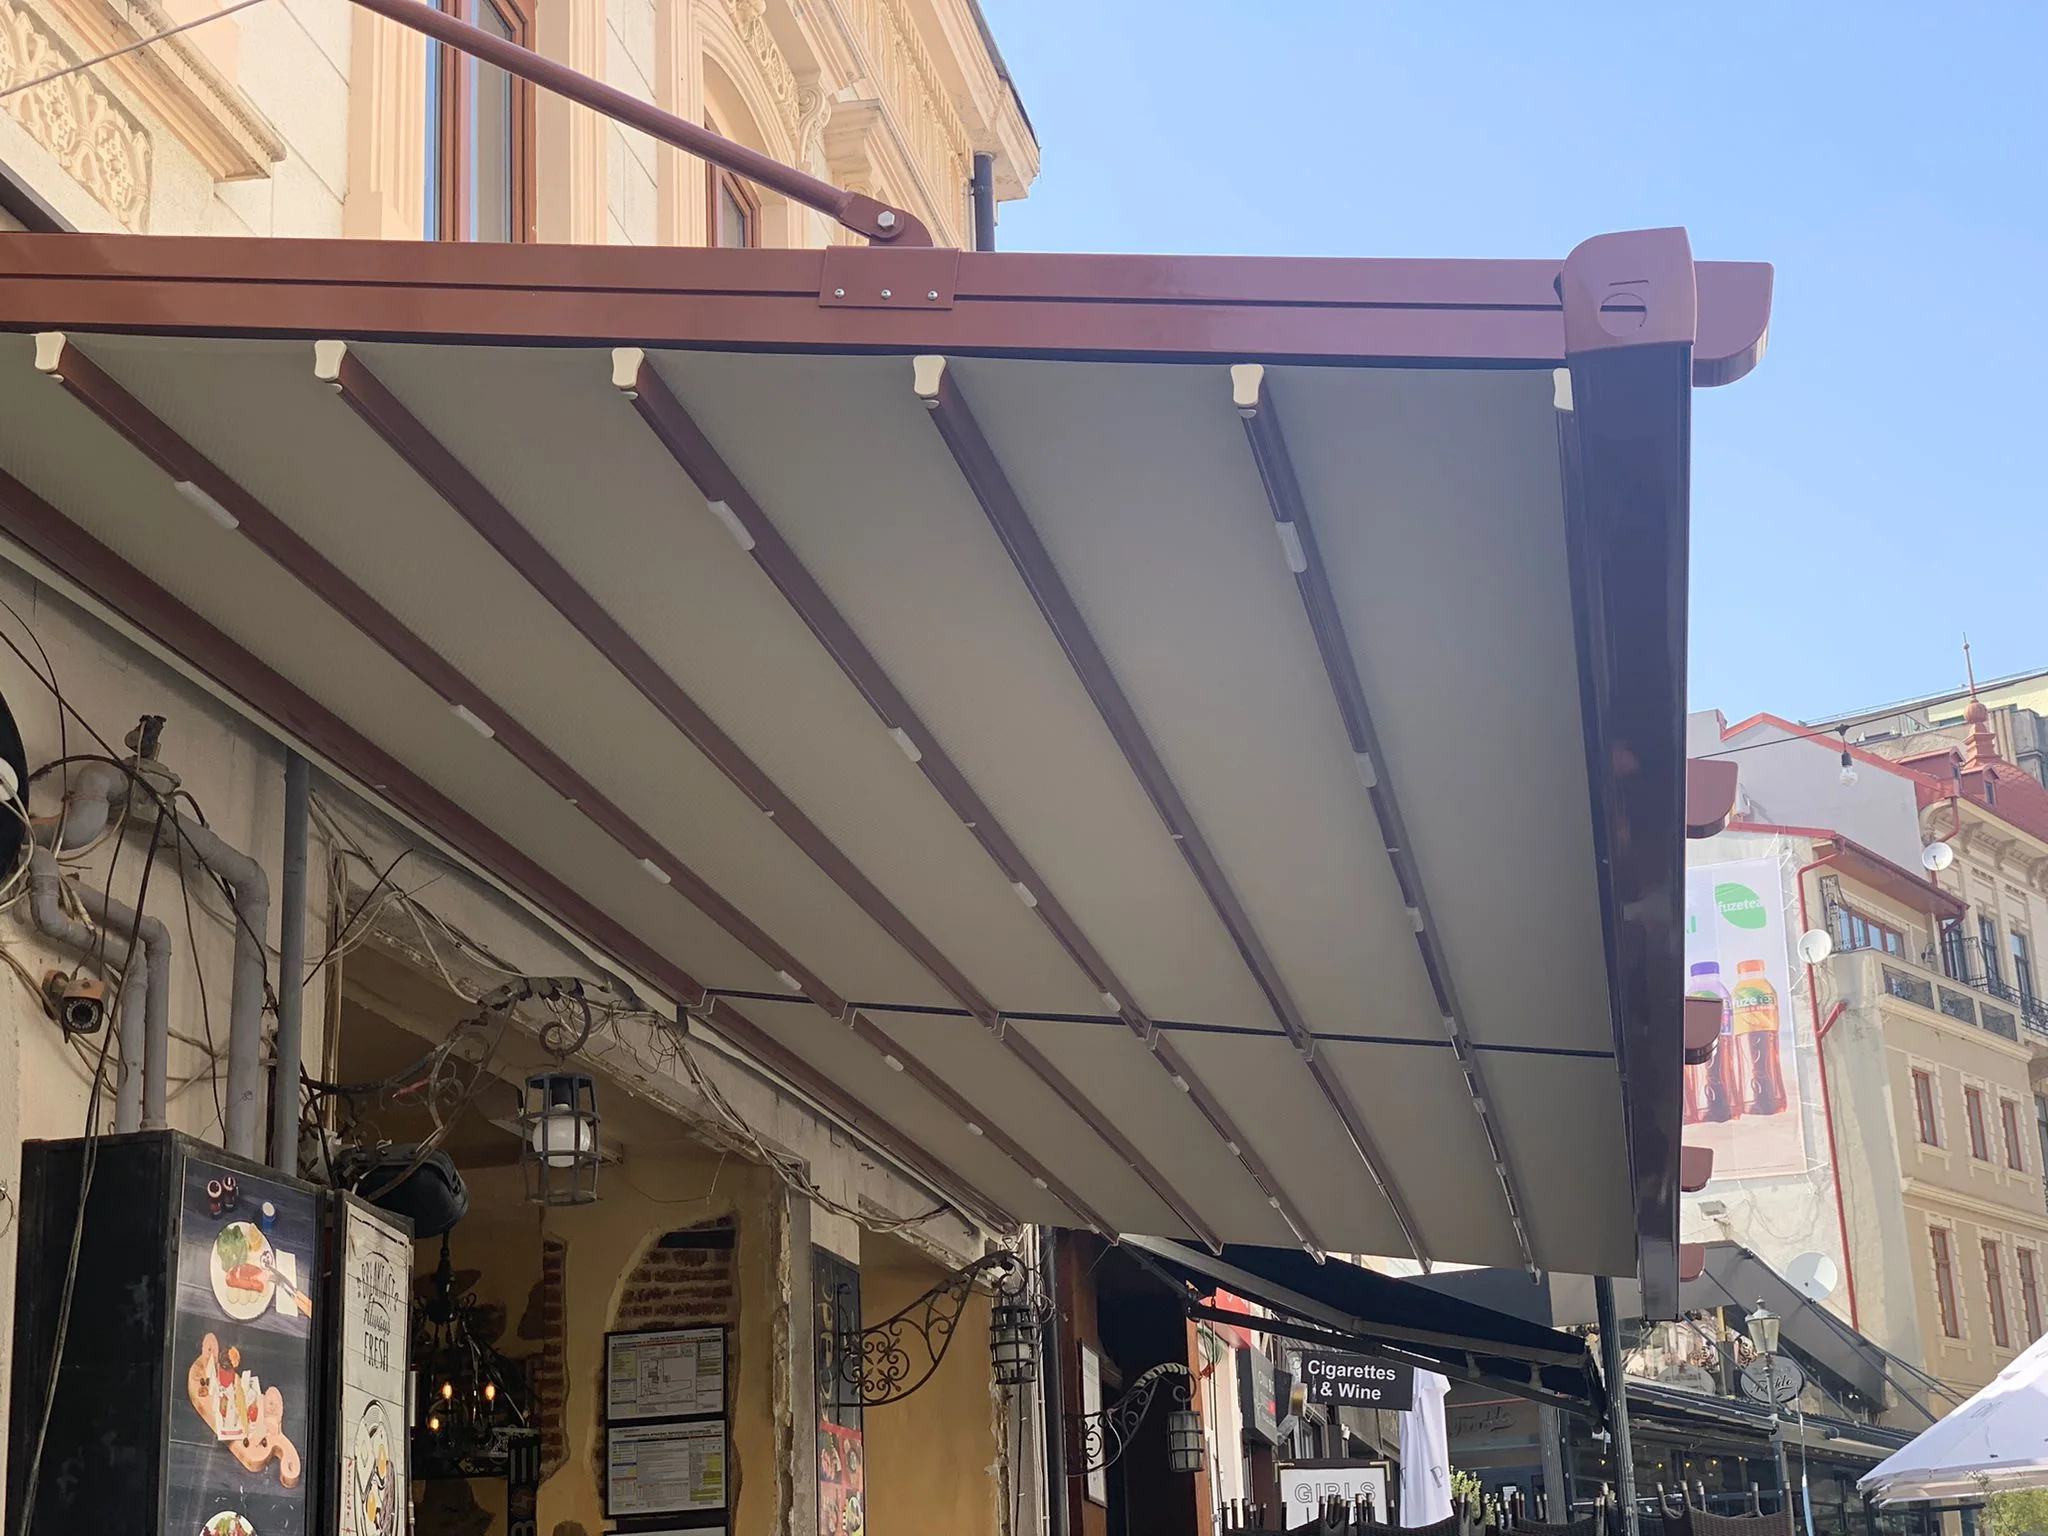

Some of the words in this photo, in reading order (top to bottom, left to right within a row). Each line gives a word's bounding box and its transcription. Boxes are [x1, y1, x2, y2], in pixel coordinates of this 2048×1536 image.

[363, 1332, 389, 1372] FRESH
[1308, 1360, 1396, 1380] Cigarettes
[1320, 1382, 1333, 1397] &
[1338, 1383, 1381, 1400] Wine
[1294, 1481, 1376, 1504] GIRLS
